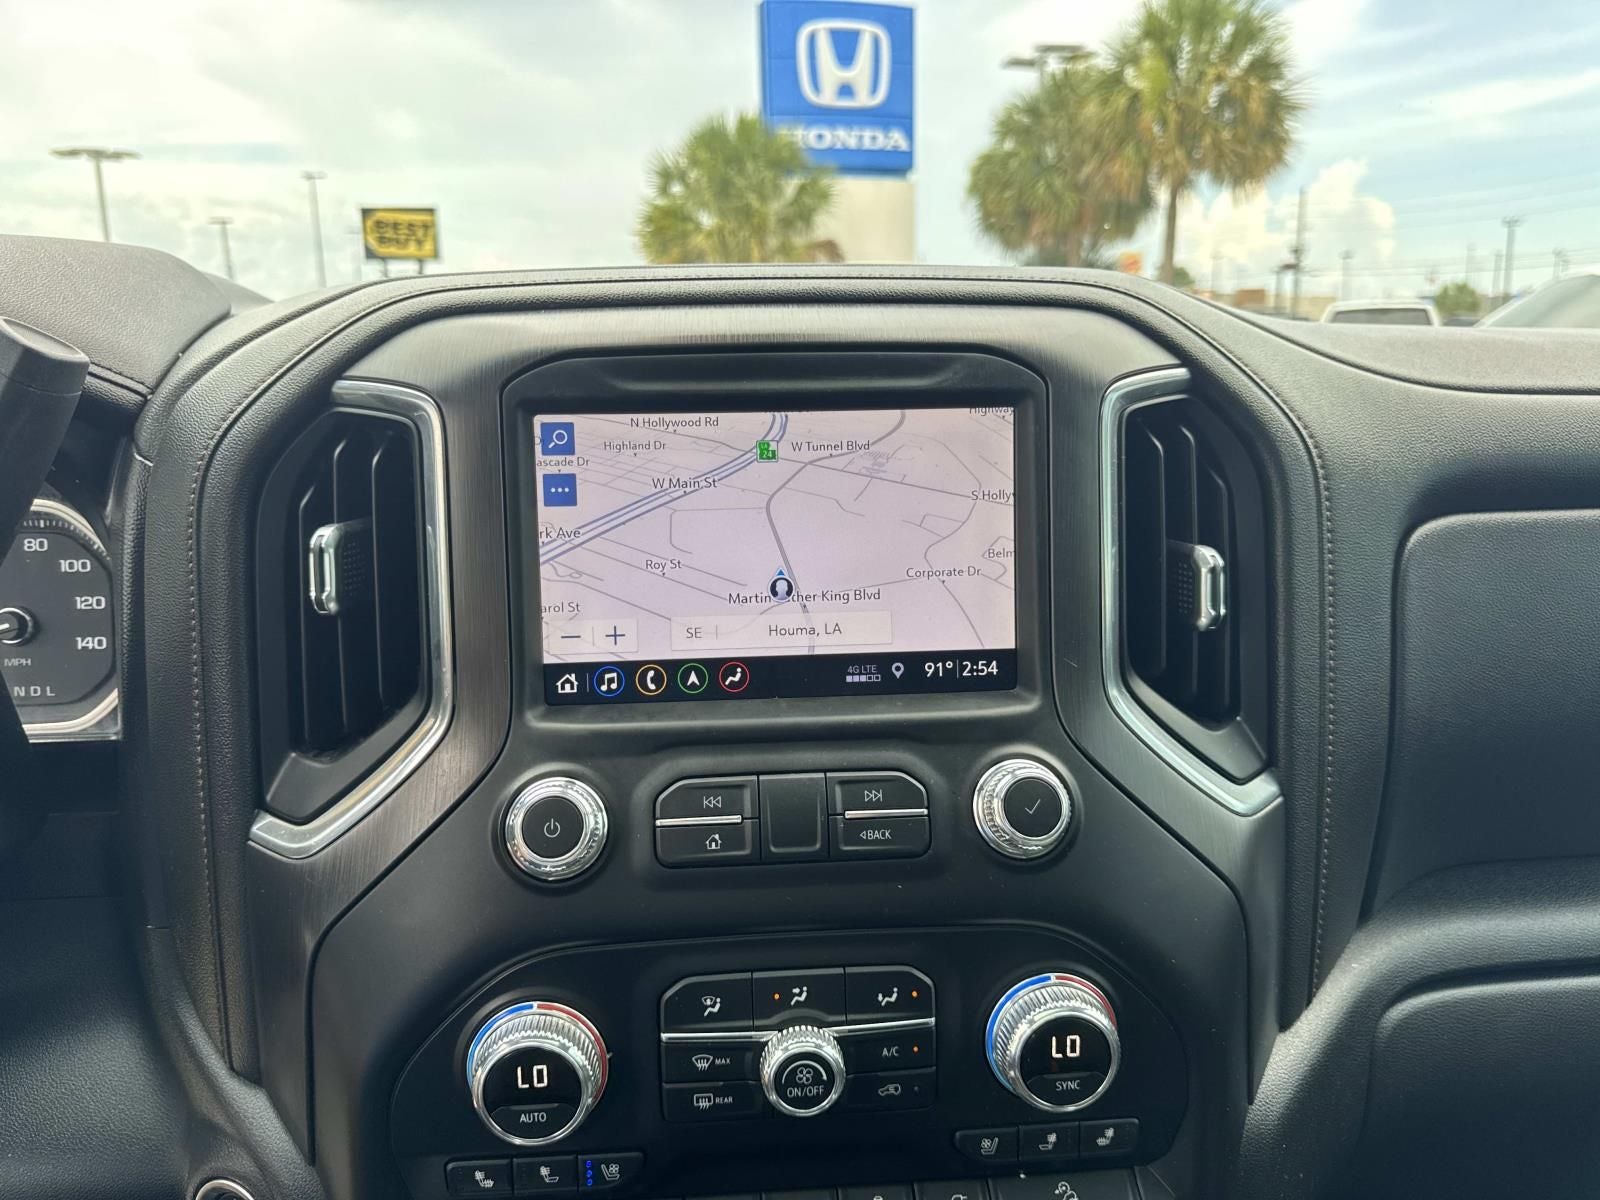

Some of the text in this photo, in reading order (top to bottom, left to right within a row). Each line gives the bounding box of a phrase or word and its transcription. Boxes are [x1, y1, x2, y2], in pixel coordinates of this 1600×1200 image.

[630, 417, 718, 429] N Hollywood Rd
[604, 441, 666, 451] Highland Dr
[792, 441, 870, 451] W Tunnel Blvd
[537, 457, 590, 466] ascade Dr
[652, 478, 717, 488] W Main St
[972, 489, 1015, 502] S Holly
[557, 528, 581, 538] Ave
[24, 538, 48, 552] 80
[59, 559, 91, 573] 100
[646, 559, 682, 574] Roy St
[906, 566, 982, 579] Corporate Dr
[729, 592, 771, 604] Martin
[822, 591, 849, 604] King
[854, 589, 880, 600] Blvd
[75, 596, 105, 610] 120
[568, 602, 580, 612] St
[686, 627, 701, 639] SE
[769, 623, 842, 636] Houma, LA
[75, 636, 107, 650] 140
[4, 658, 32, 667] MPH
[962, 660, 998, 676] 2:54
[847, 664, 877, 673] 4G LTE
[14, 686, 56, 697] N D L
[868, 829, 891, 840] BACK
[882, 1047, 900, 1057] A/C
[1051, 1035, 1081, 1058] LO
[715, 1057, 731, 1065] MAX
[517, 1065, 548, 1089] LO
[1056, 1080, 1080, 1090] SYNC
[787, 1086, 824, 1097] ON/OFF
[715, 1096, 733, 1104] REAR
[520, 1112, 547, 1123] AUTO
